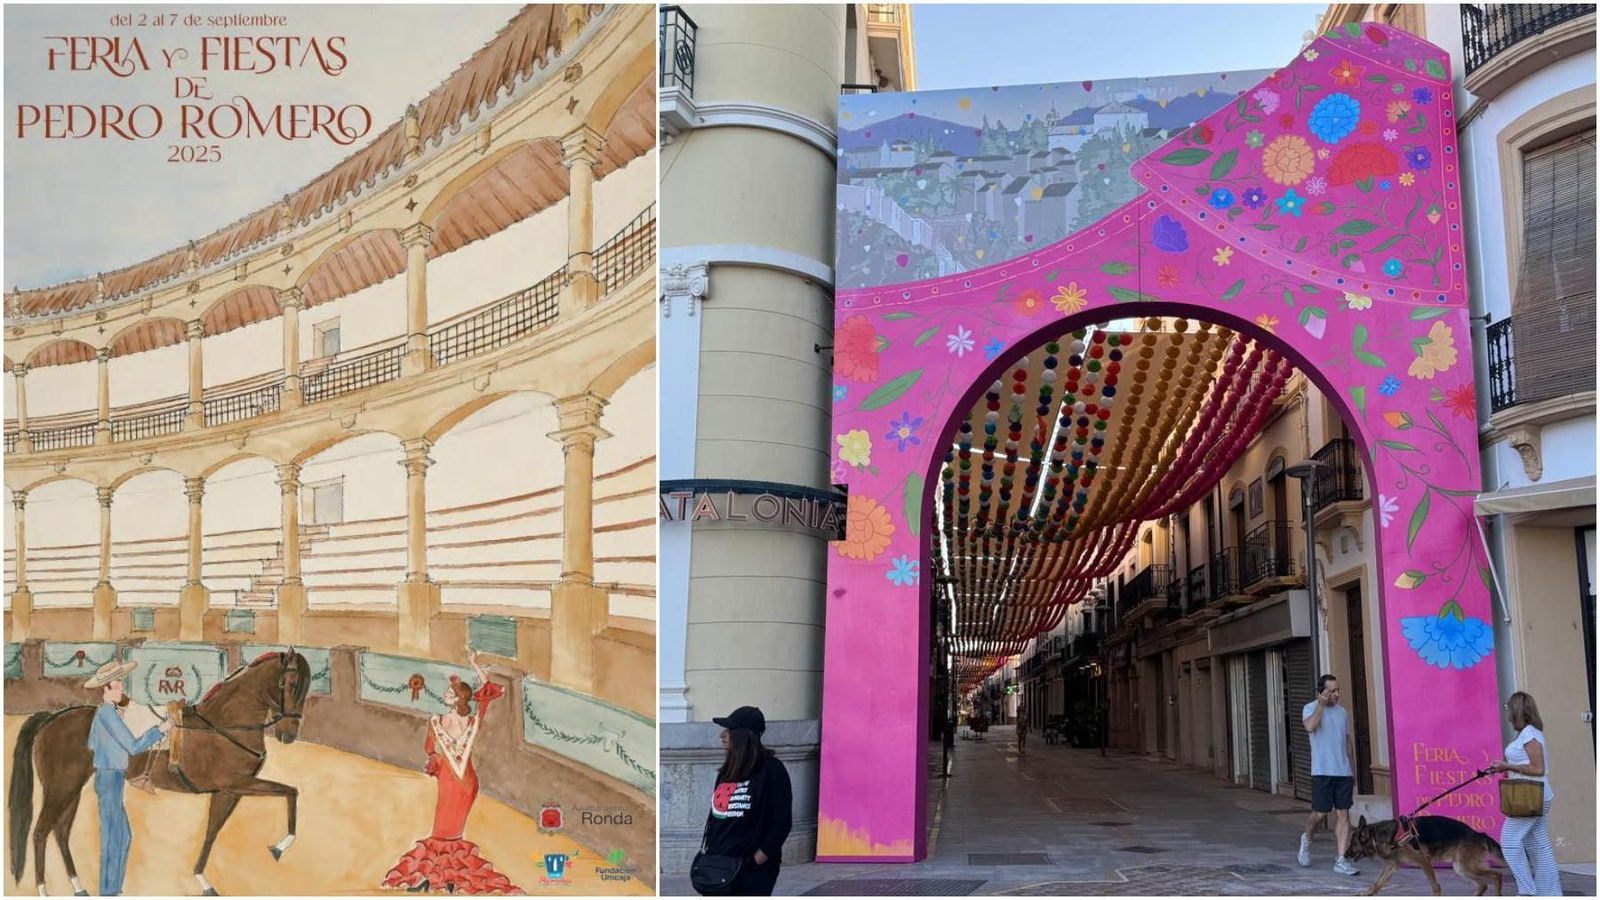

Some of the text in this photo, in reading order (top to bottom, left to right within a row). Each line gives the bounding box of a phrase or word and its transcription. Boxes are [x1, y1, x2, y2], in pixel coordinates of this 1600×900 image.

[110, 14, 288, 28] del 2 al 7 de septiembre
[43, 36, 151, 77] FERIA
[201, 36, 348, 77] FIESTAS
[174, 76, 213, 100] DE
[16, 95, 373, 145] PEDRO ROMERO
[167, 145, 222, 163] 2025
[1413, 742, 1470, 765] FERIA
[582, 812, 633, 825] Ronda
